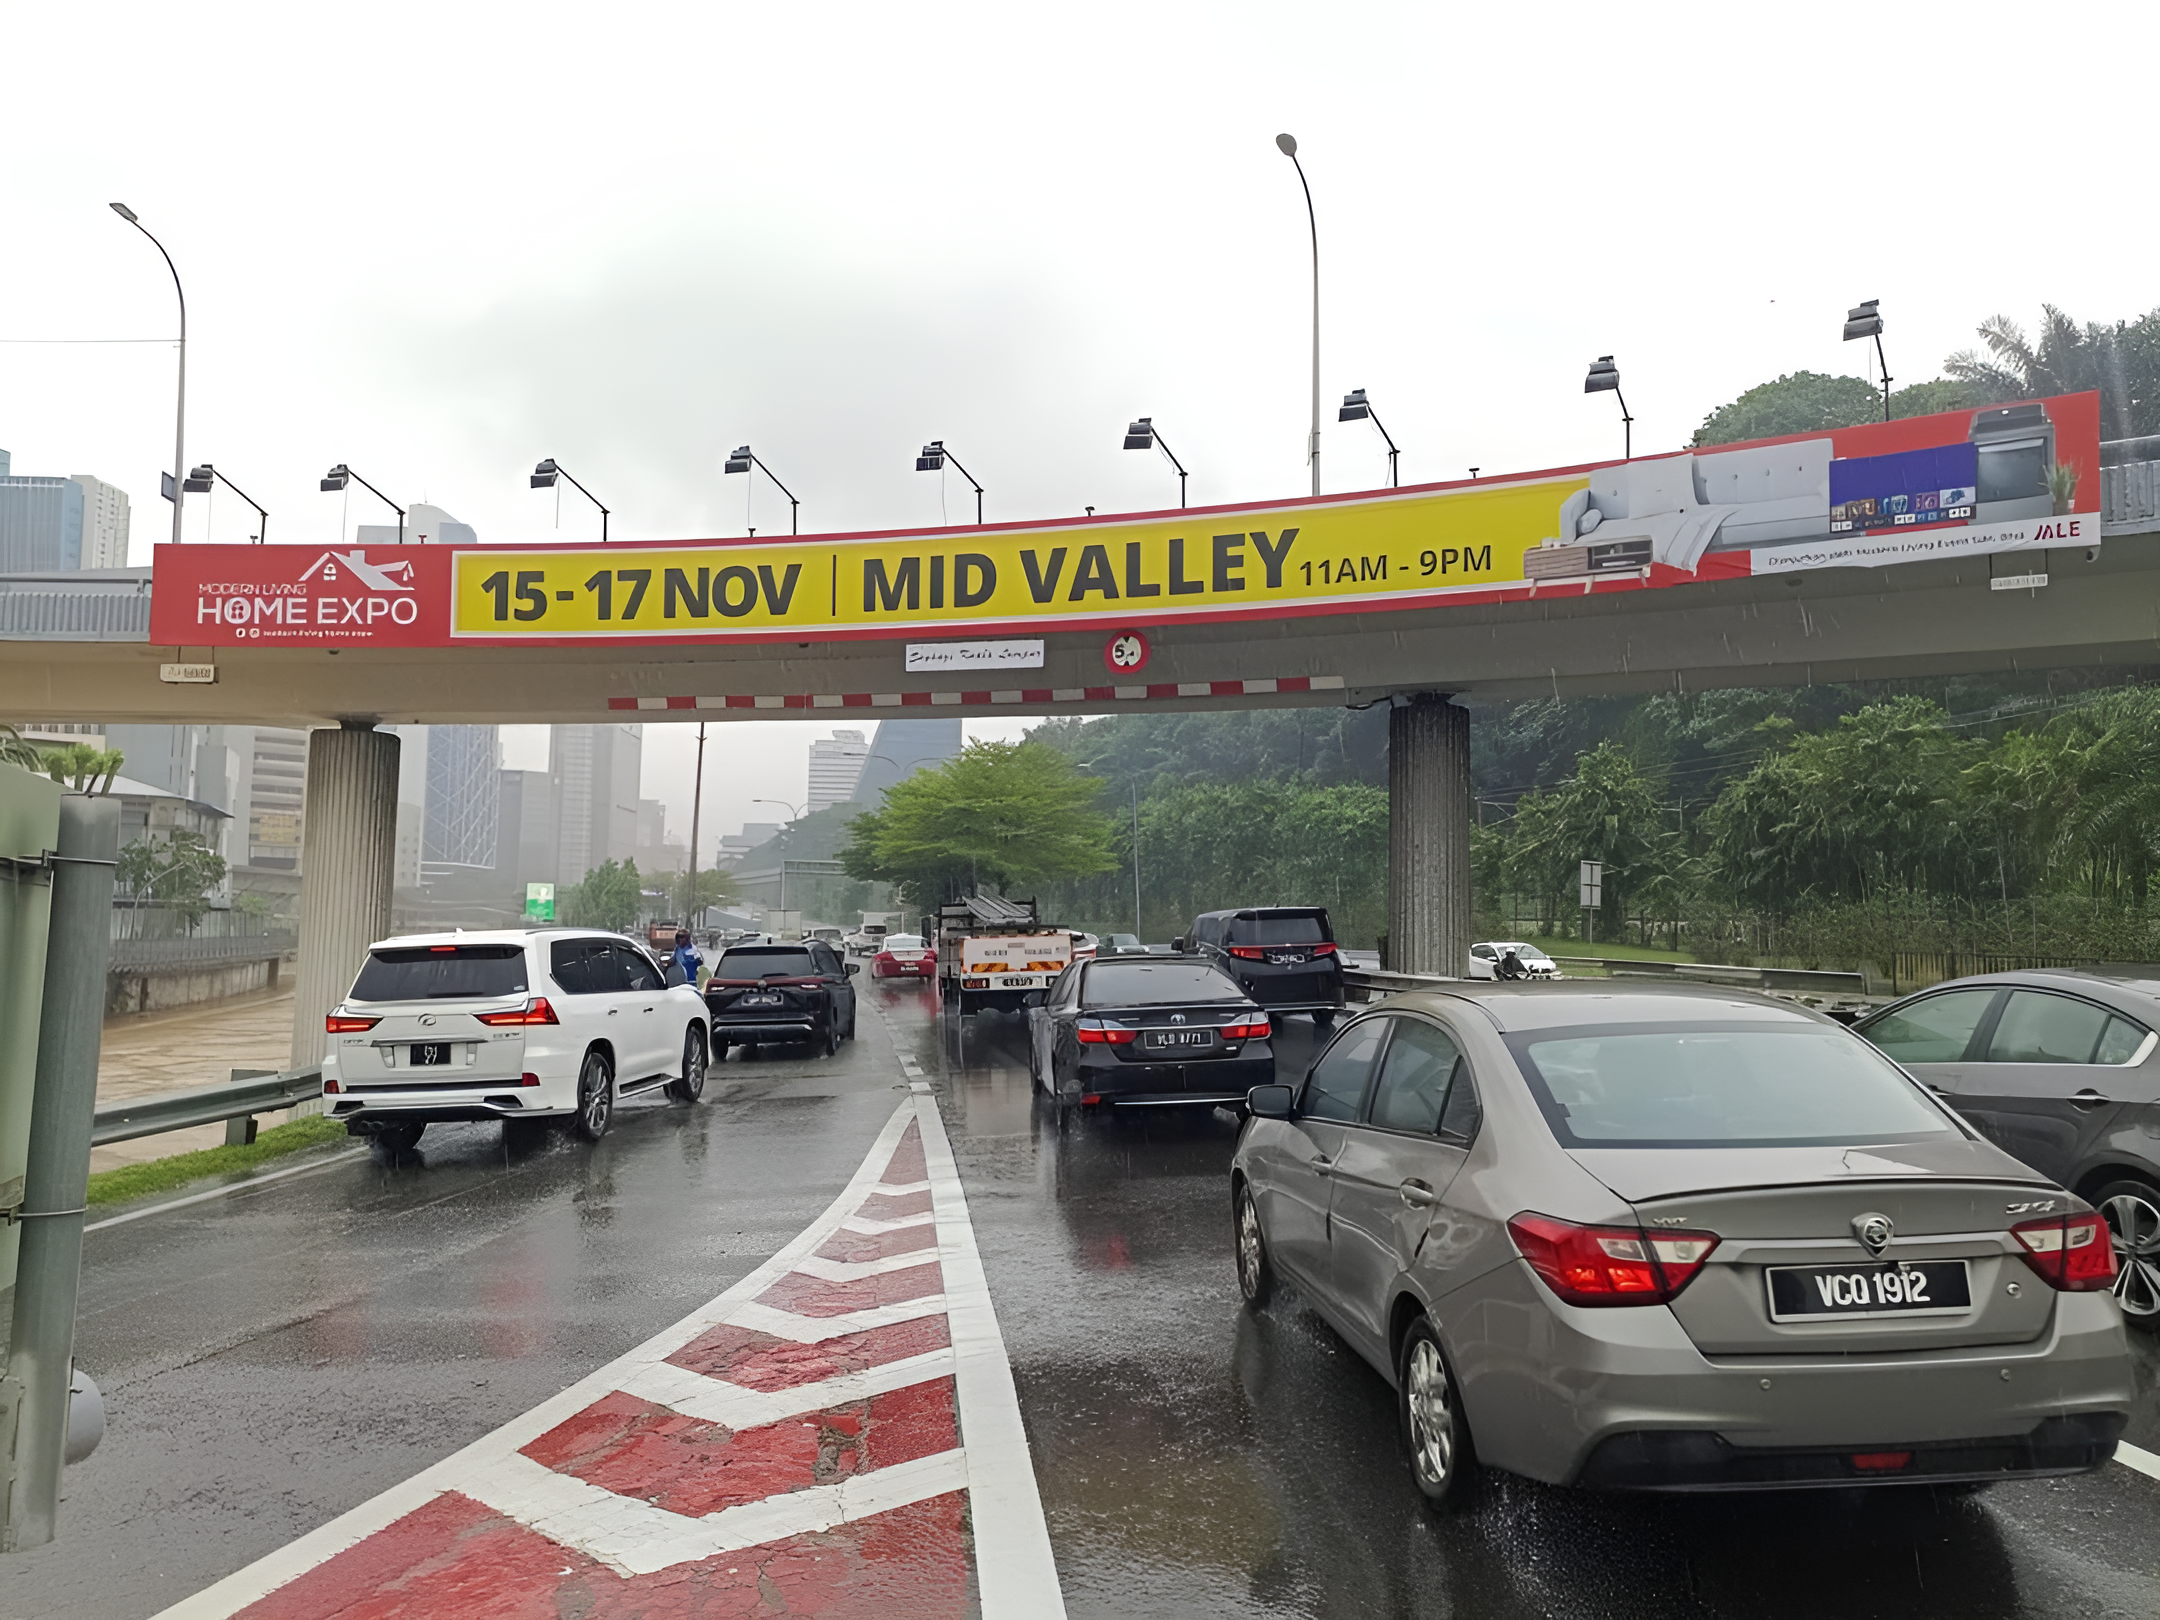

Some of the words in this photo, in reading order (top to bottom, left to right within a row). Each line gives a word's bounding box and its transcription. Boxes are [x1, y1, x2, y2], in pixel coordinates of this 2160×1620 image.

[863, 553, 997, 613] MID
[1019, 528, 1300, 604] VALLEY
[1299, 554, 1388, 587] 11AM
[1420, 545, 1491, 576] 9PM
[197, 597, 307, 625] HOME
[317, 597, 418, 625] EXPO
[664, 564, 802, 618] NOV
[1872, 1271, 1931, 1304] 1912
